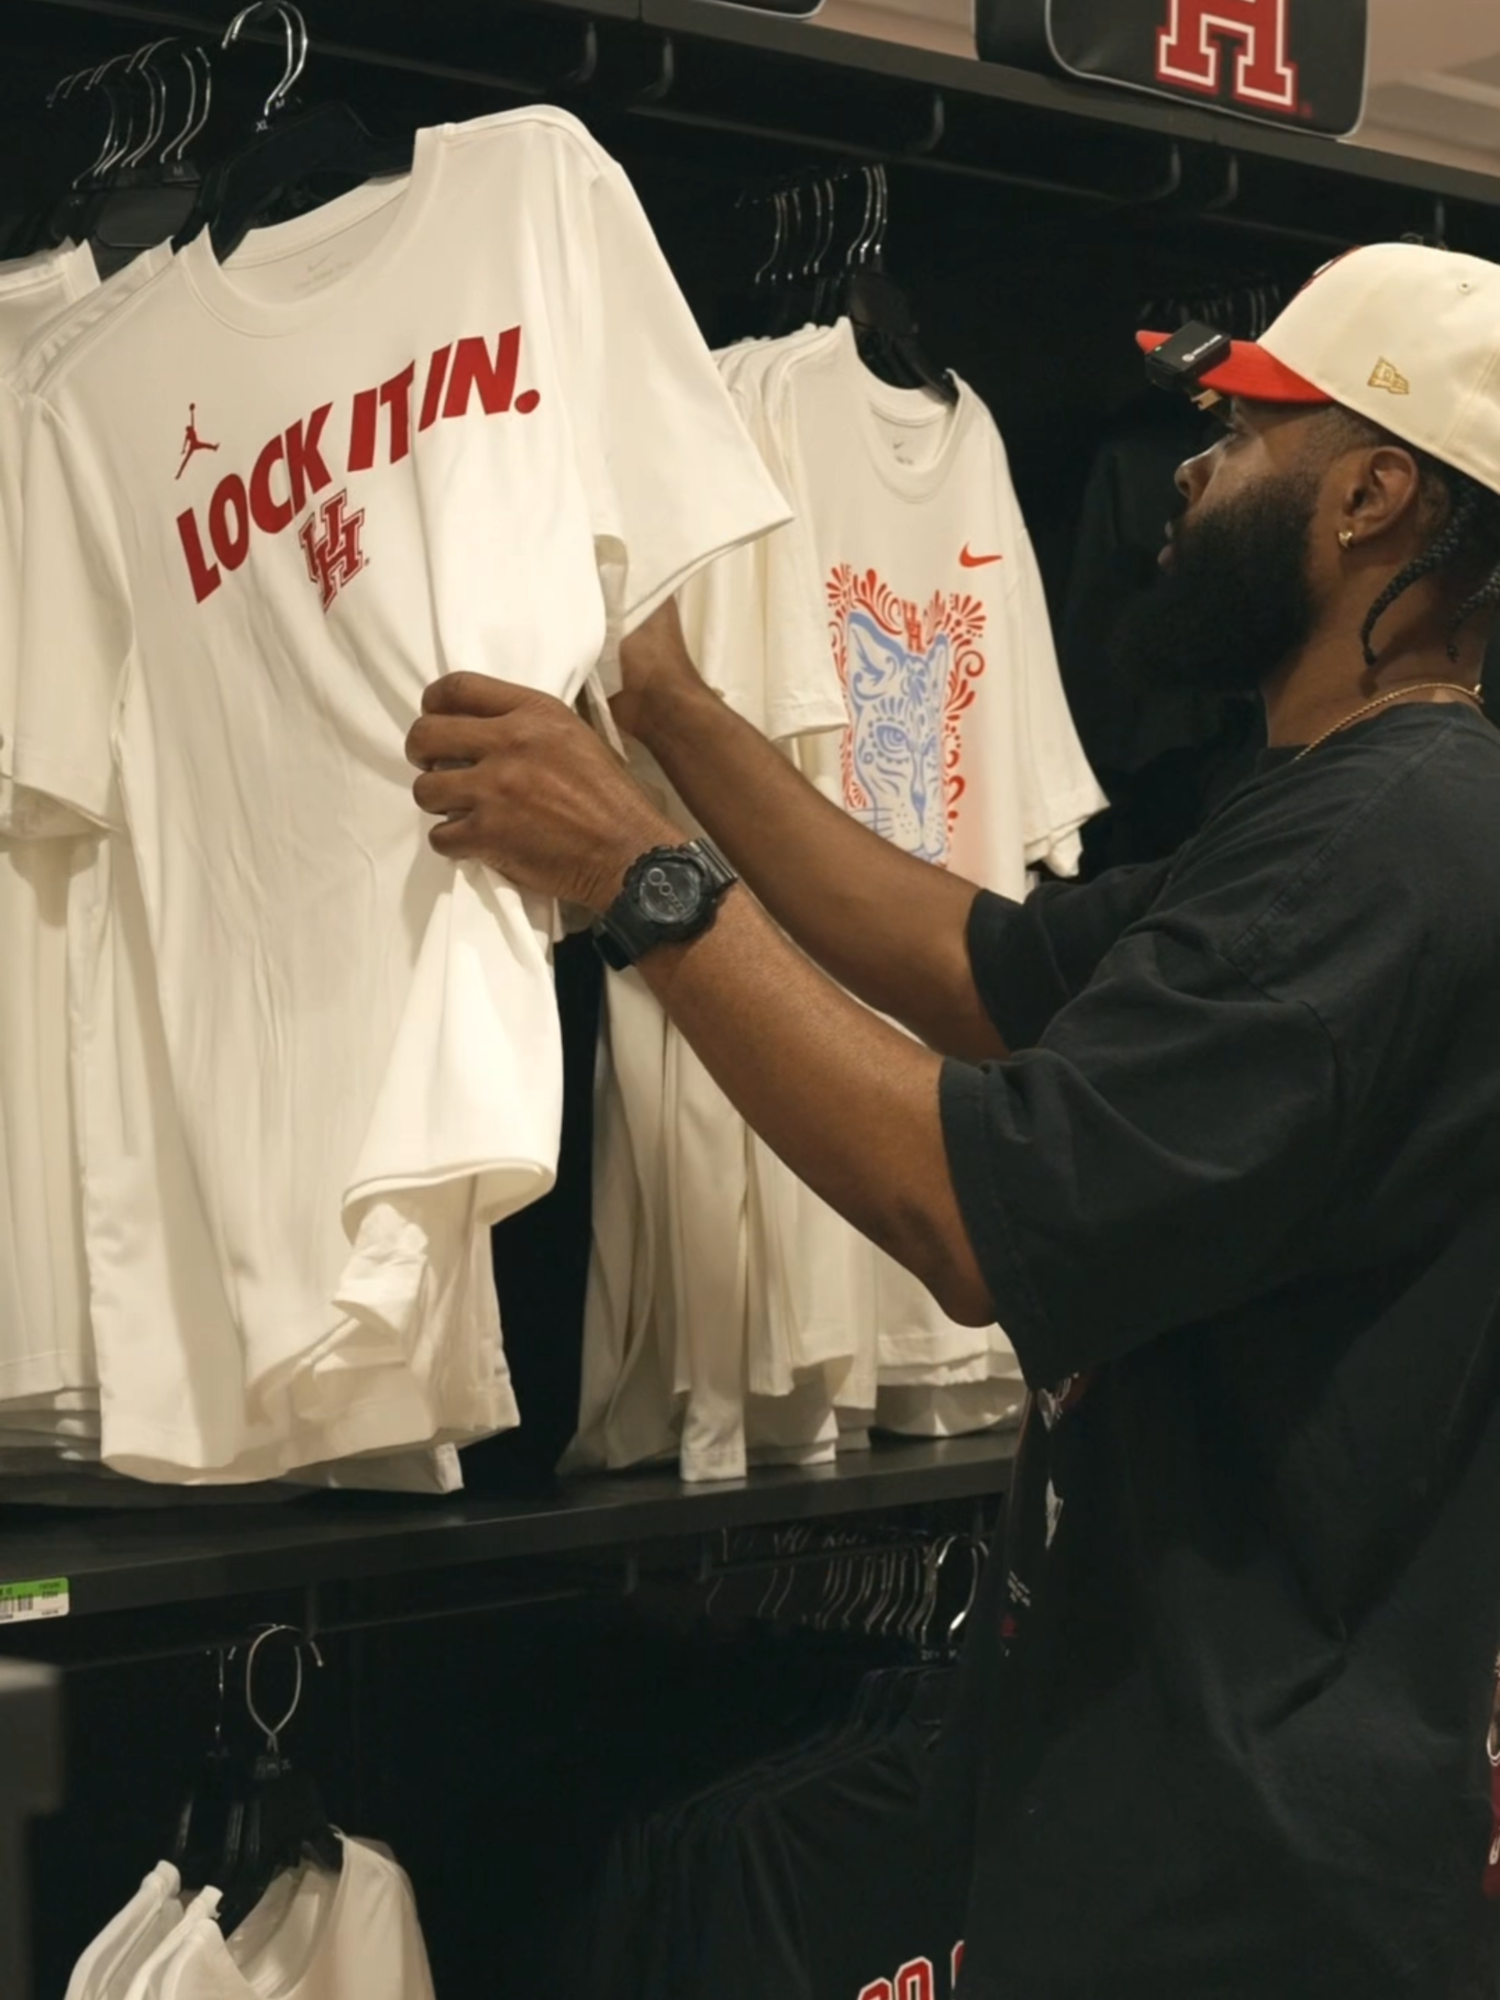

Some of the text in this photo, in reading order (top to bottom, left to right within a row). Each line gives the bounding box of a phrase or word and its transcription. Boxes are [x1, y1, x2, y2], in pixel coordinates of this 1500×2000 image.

[176, 325, 541, 604] LOCK IT IN.
